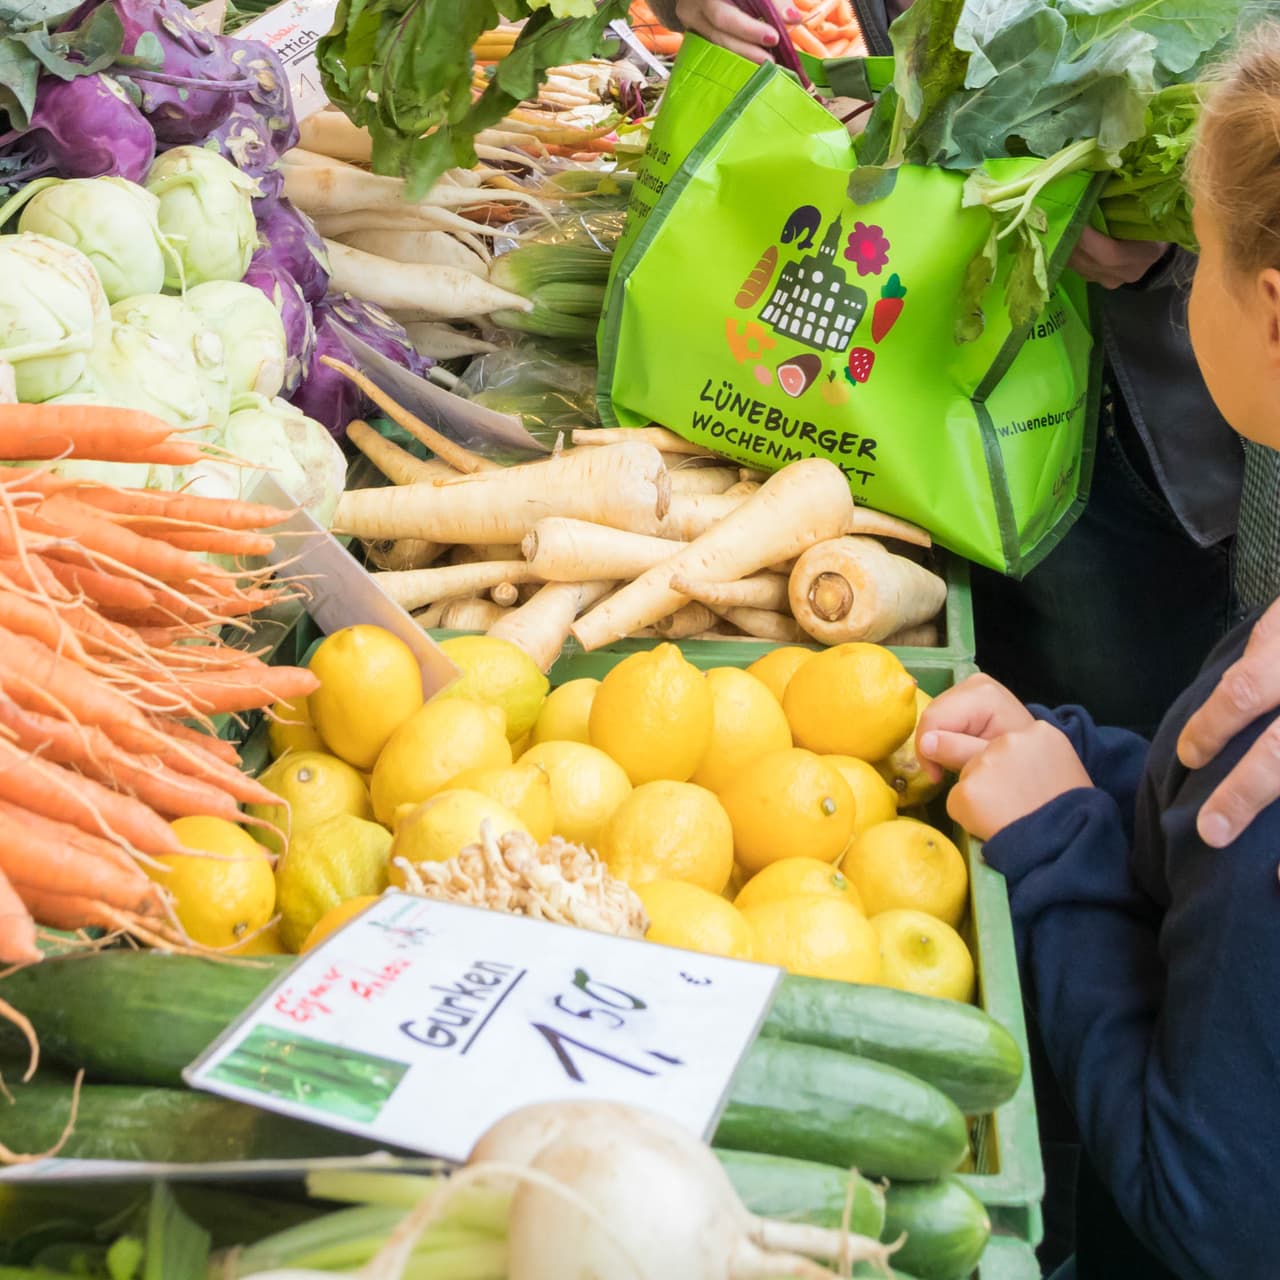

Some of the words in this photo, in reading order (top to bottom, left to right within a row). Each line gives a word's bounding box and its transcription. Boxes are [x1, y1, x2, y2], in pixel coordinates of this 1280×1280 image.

[277, 30, 320, 58] ttich
[691, 410, 876, 486] WOCHENMKT
[699, 378, 878, 462] LÜNEBURGER
[399, 960, 516, 1049] Gurken
